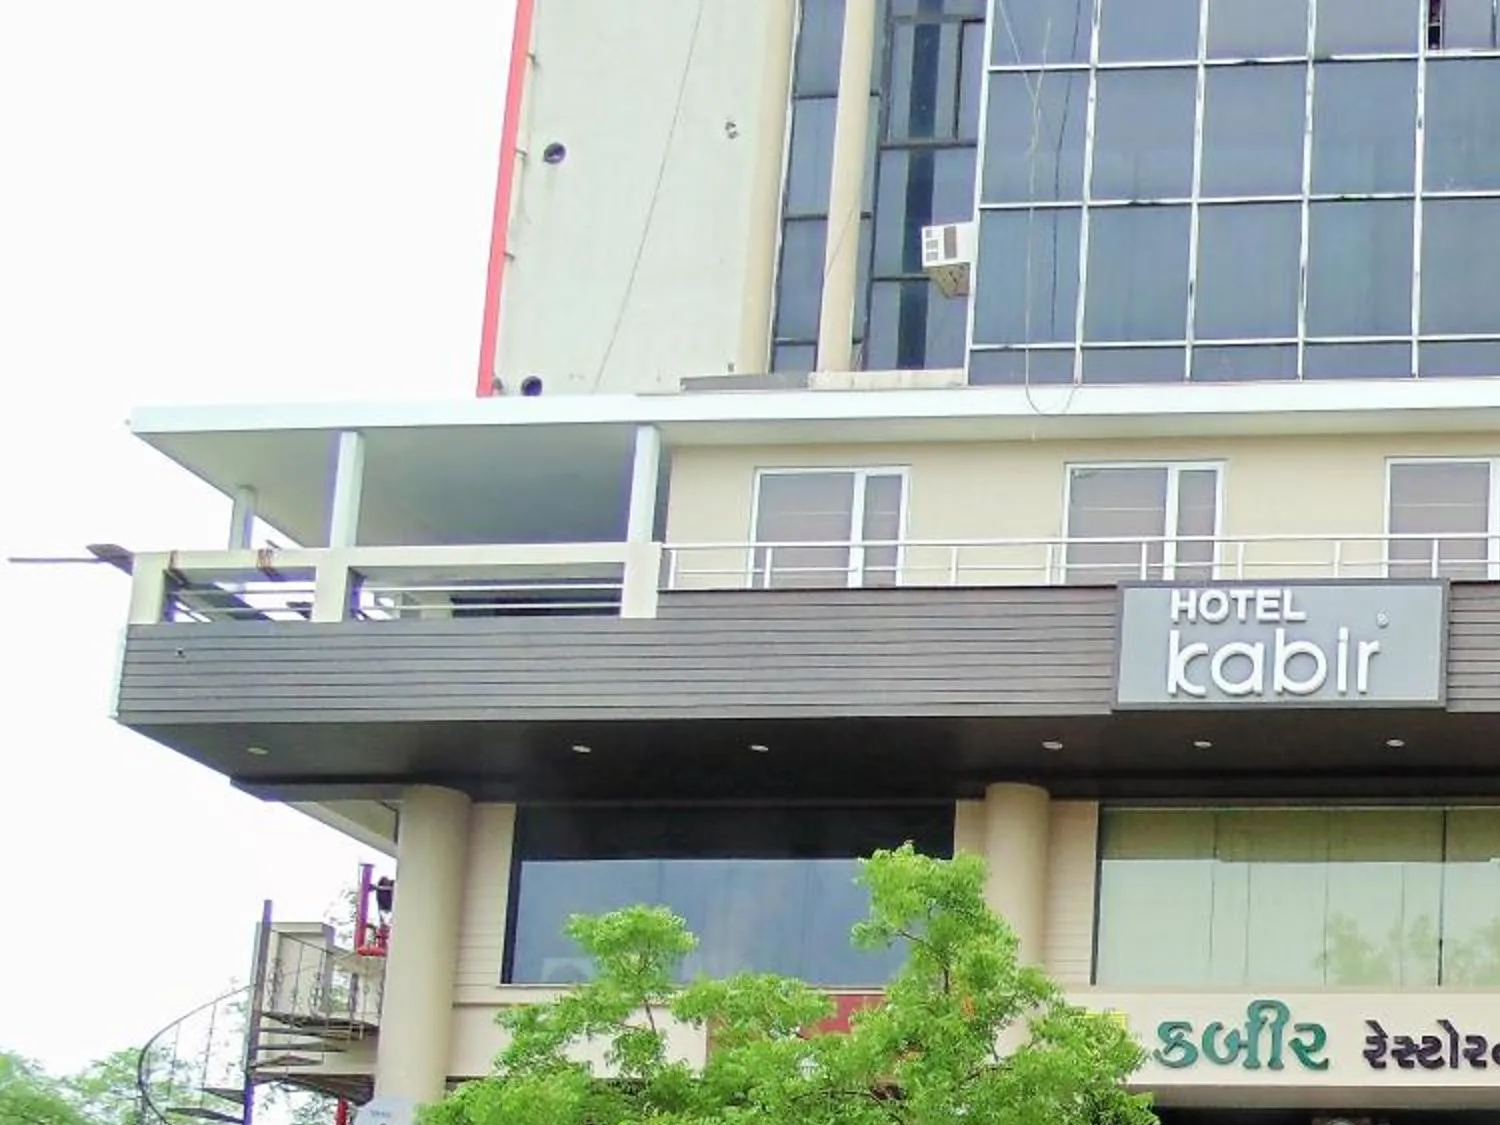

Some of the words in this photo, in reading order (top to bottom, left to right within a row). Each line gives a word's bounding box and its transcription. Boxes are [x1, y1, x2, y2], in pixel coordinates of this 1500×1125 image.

[1170, 588, 1307, 624] HOTEL
[1167, 627, 1381, 698] kabir
[1153, 999, 1330, 1071] કબીર
